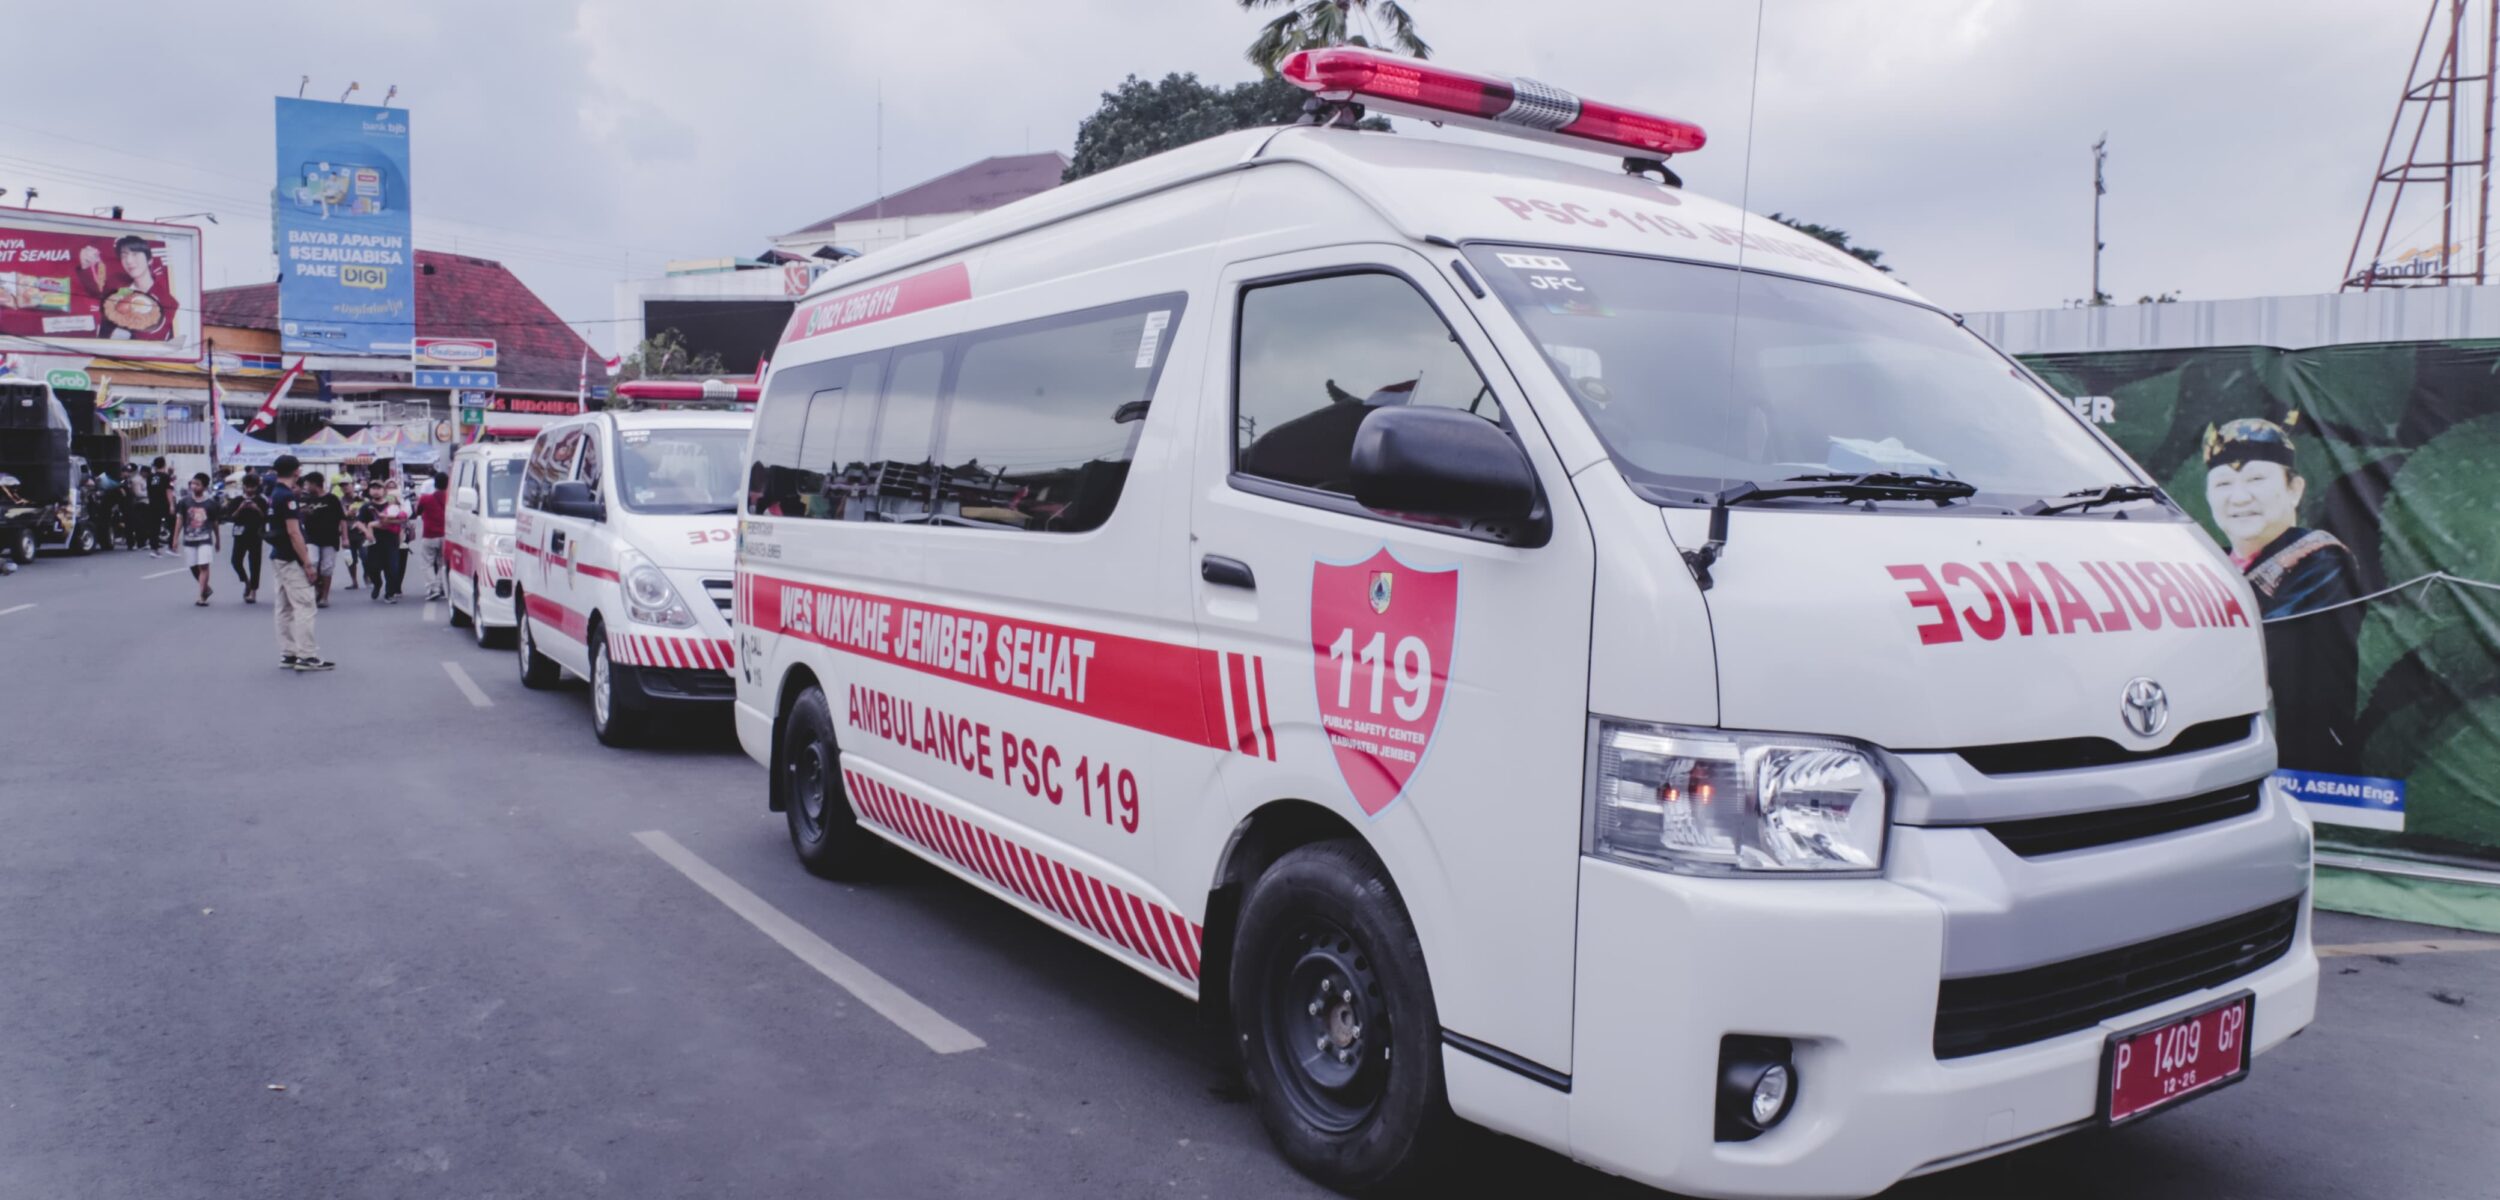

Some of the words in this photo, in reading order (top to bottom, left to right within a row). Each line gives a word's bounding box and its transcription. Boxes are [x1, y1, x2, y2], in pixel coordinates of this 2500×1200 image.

[1493, 196, 1608, 229] PSC
[1608, 207, 1698, 240] 119
[288, 230, 339, 245] BAYAR
[341, 233, 403, 249] APAPUN
[19, 249, 71, 262] SEMUA
[289, 245, 404, 265] #SEMUABISA
[296, 263, 338, 278] PAKE
[344, 268, 385, 285] DIGI
[1530, 275, 1585, 292] JFC
[51, 373, 86, 388] Grab
[780, 584, 812, 632] WES
[816, 588, 891, 654] WAYAHE
[894, 608, 989, 678] JEMBER
[994, 624, 1096, 703] SEHAT
[1329, 627, 1432, 722] 119
[1323, 714, 1353, 731] PUBLIC
[1354, 720, 1388, 737] SAFETY
[1388, 727, 1426, 745] CENTER
[848, 683, 994, 780] AMBULANCE
[1002, 731, 1064, 805] PSC
[1074, 755, 1140, 834] 119
[1331, 734, 1379, 756] KABUPATEN
[1379, 744, 1417, 764] JEMBER
[2304, 780, 2360, 798] ASEAN
[2362, 785, 2400, 805] Eng.
[2116, 1043, 2132, 1091] P
[2153, 1020, 2201, 1078] 1409
[2218, 1005, 2243, 1053] GP
